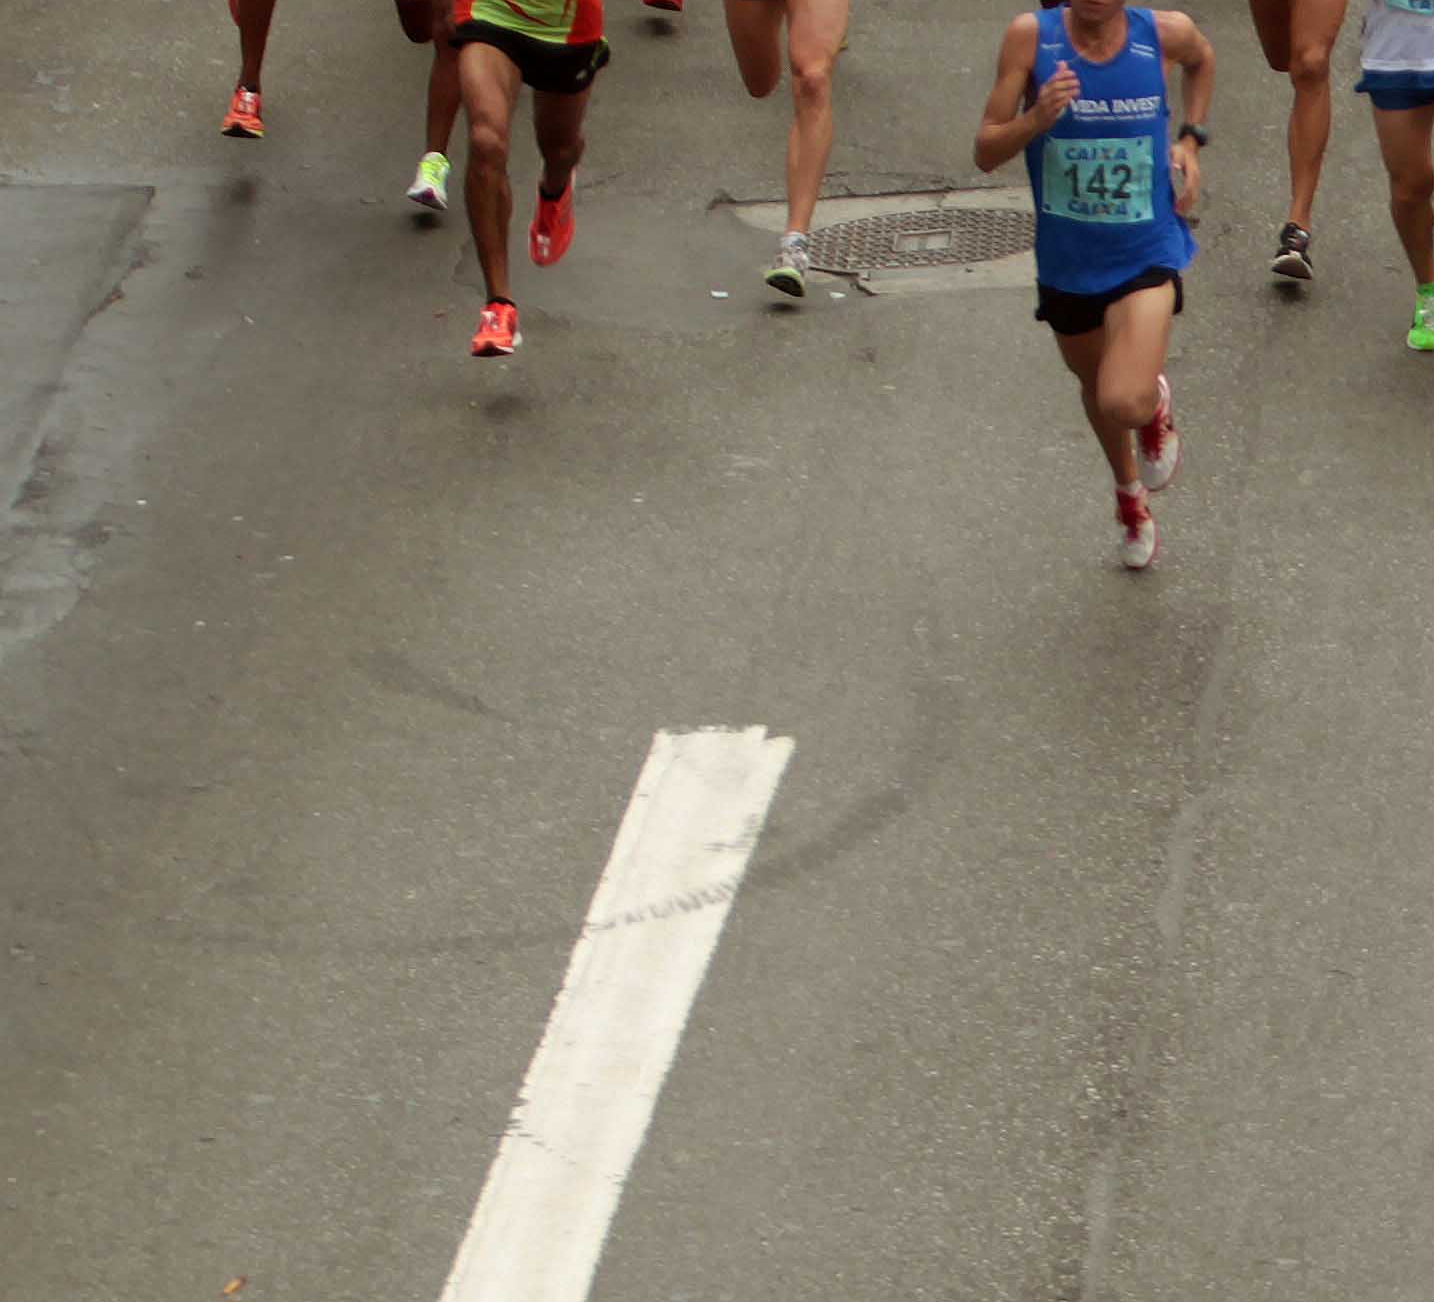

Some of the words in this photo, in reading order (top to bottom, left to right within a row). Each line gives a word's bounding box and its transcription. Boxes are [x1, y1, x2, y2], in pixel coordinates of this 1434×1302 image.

[1064, 147, 1128, 161] CAIXA
[1064, 163, 1134, 201] 142
[1067, 200, 1128, 217] CAIXA
